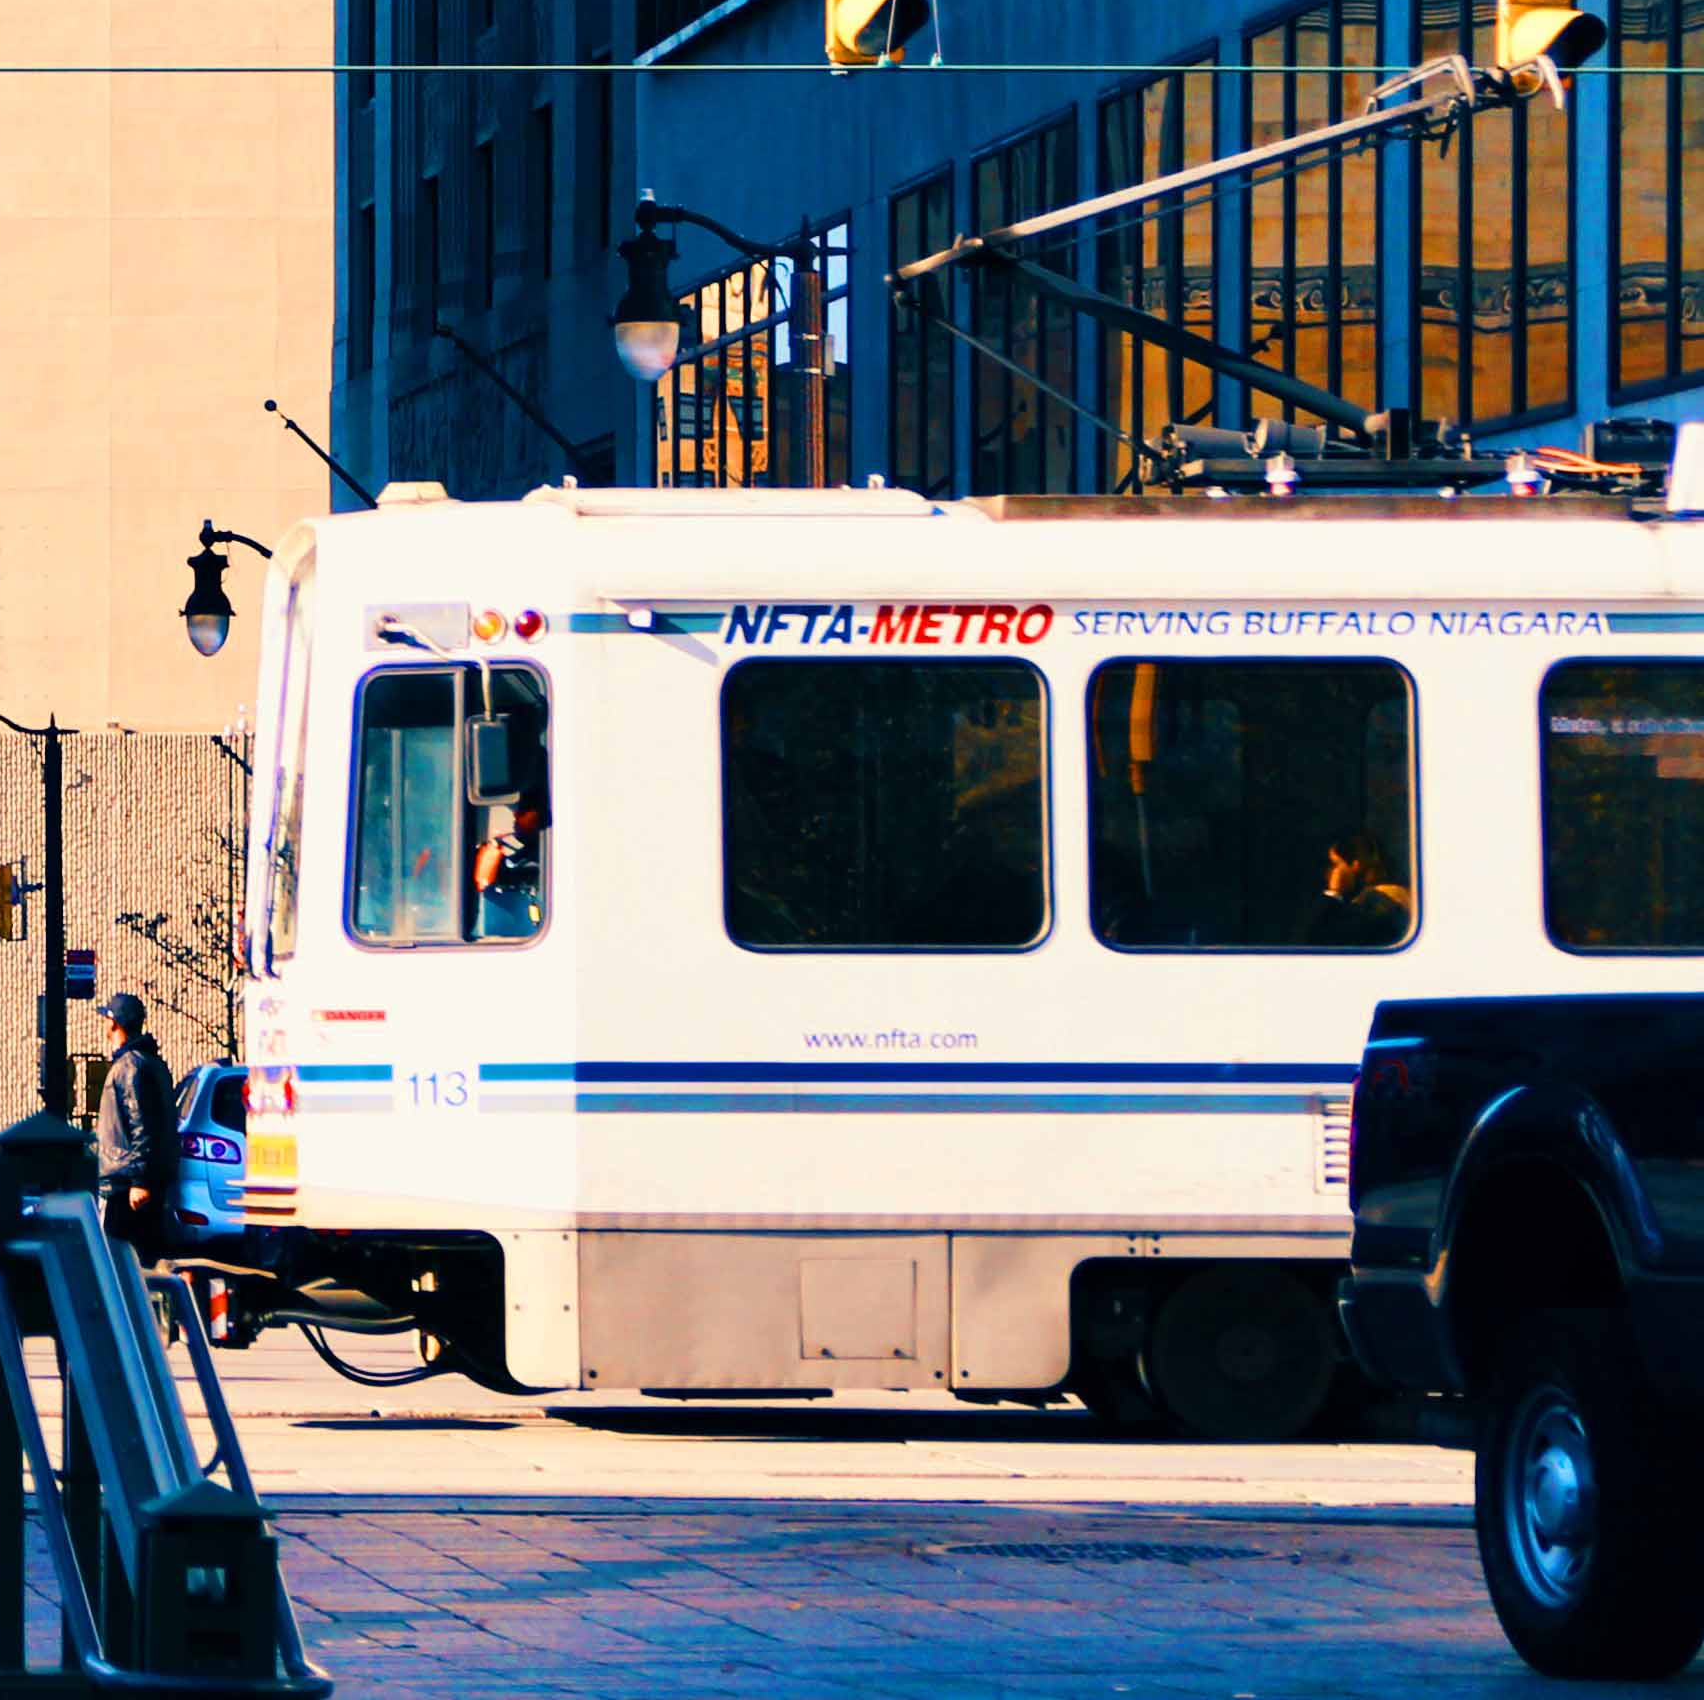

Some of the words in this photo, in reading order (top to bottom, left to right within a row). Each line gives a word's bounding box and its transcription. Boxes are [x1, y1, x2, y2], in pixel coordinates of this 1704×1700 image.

[724, 603, 1055, 645] NFTA-METRO
[1072, 611, 1232, 635] SERVING
[1243, 611, 1416, 635] BUFFALO
[1430, 611, 1602, 635] NIAGARA
[325, 1011, 385, 1020] DANGER
[802, 1028, 978, 1048] www.nfta.com
[407, 1071, 469, 1107] 113
